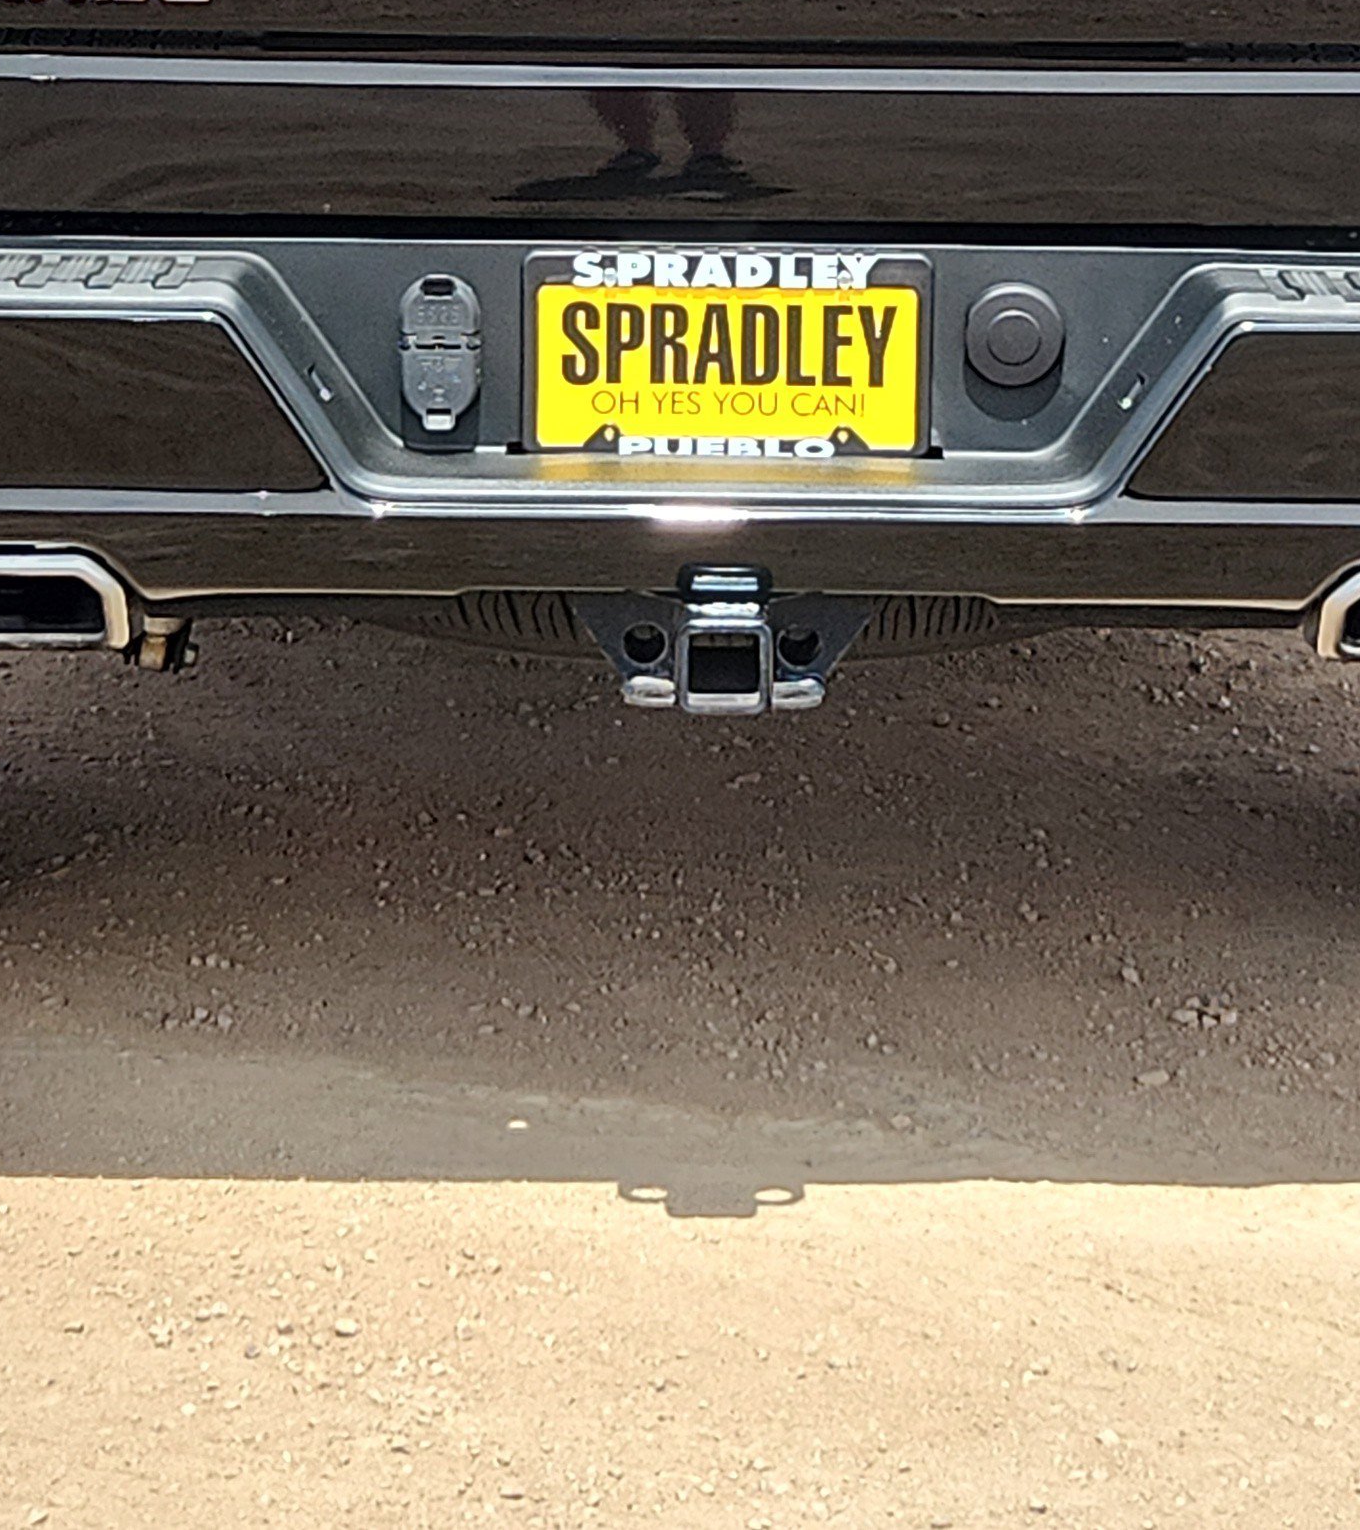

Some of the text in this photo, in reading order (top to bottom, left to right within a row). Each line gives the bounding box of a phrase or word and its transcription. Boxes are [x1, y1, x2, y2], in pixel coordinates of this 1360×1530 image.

[572, 252, 878, 290] SPRADLEY
[560, 300, 898, 388] SPRADLEY
[591, 389, 865, 418] OH YES YOU CAN!
[617, 434, 836, 459] PUEBLO
